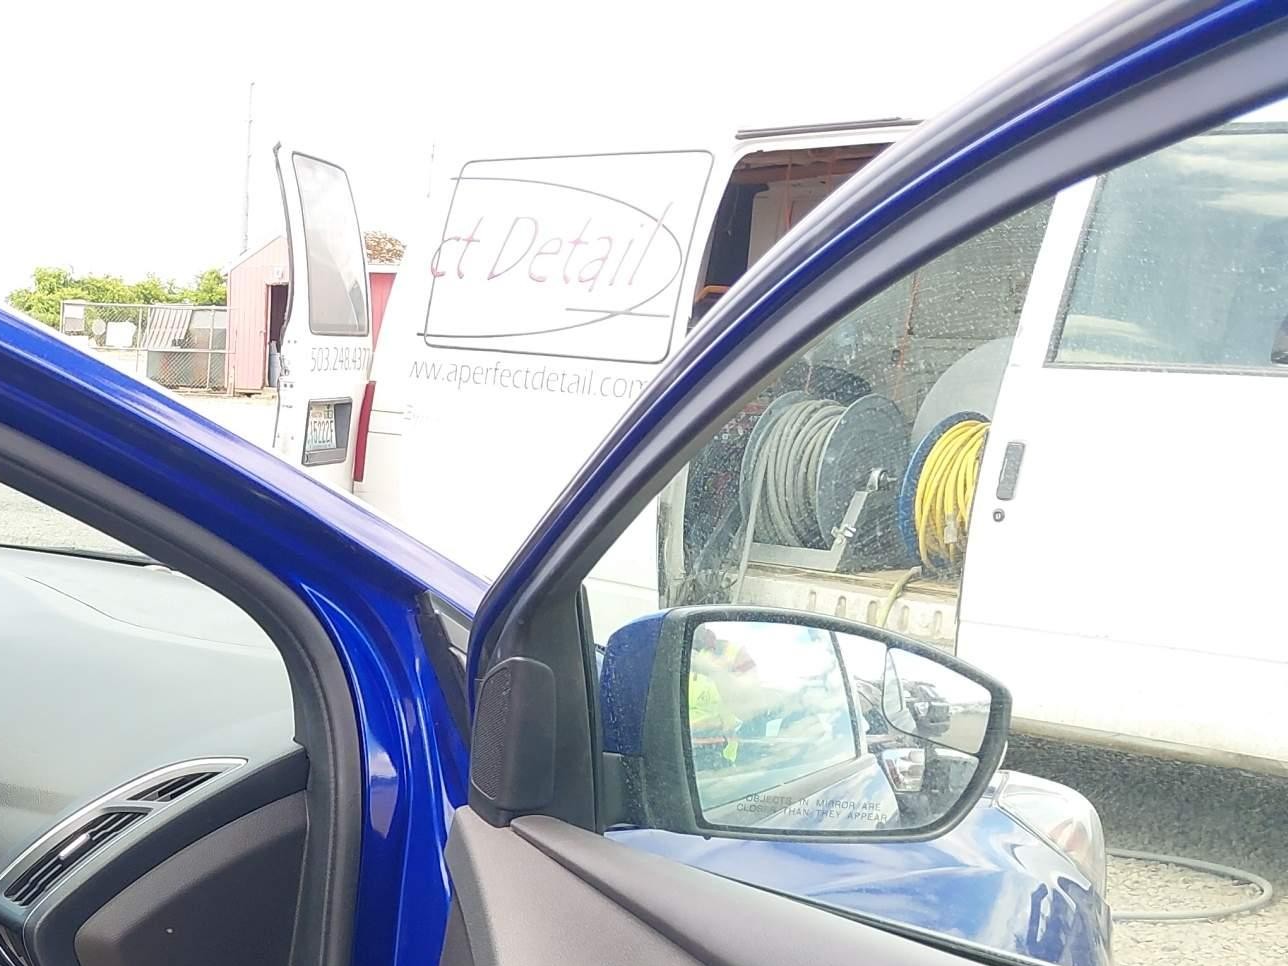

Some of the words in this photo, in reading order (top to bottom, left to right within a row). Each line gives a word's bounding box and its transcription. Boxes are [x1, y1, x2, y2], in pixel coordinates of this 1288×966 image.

[487, 200, 672, 293] Detail
[815, 799, 855, 810] MIRROR
[861, 801, 881, 812] ARE
[815, 809, 841, 818] THEY
[847, 811, 888, 822] APPEAR
